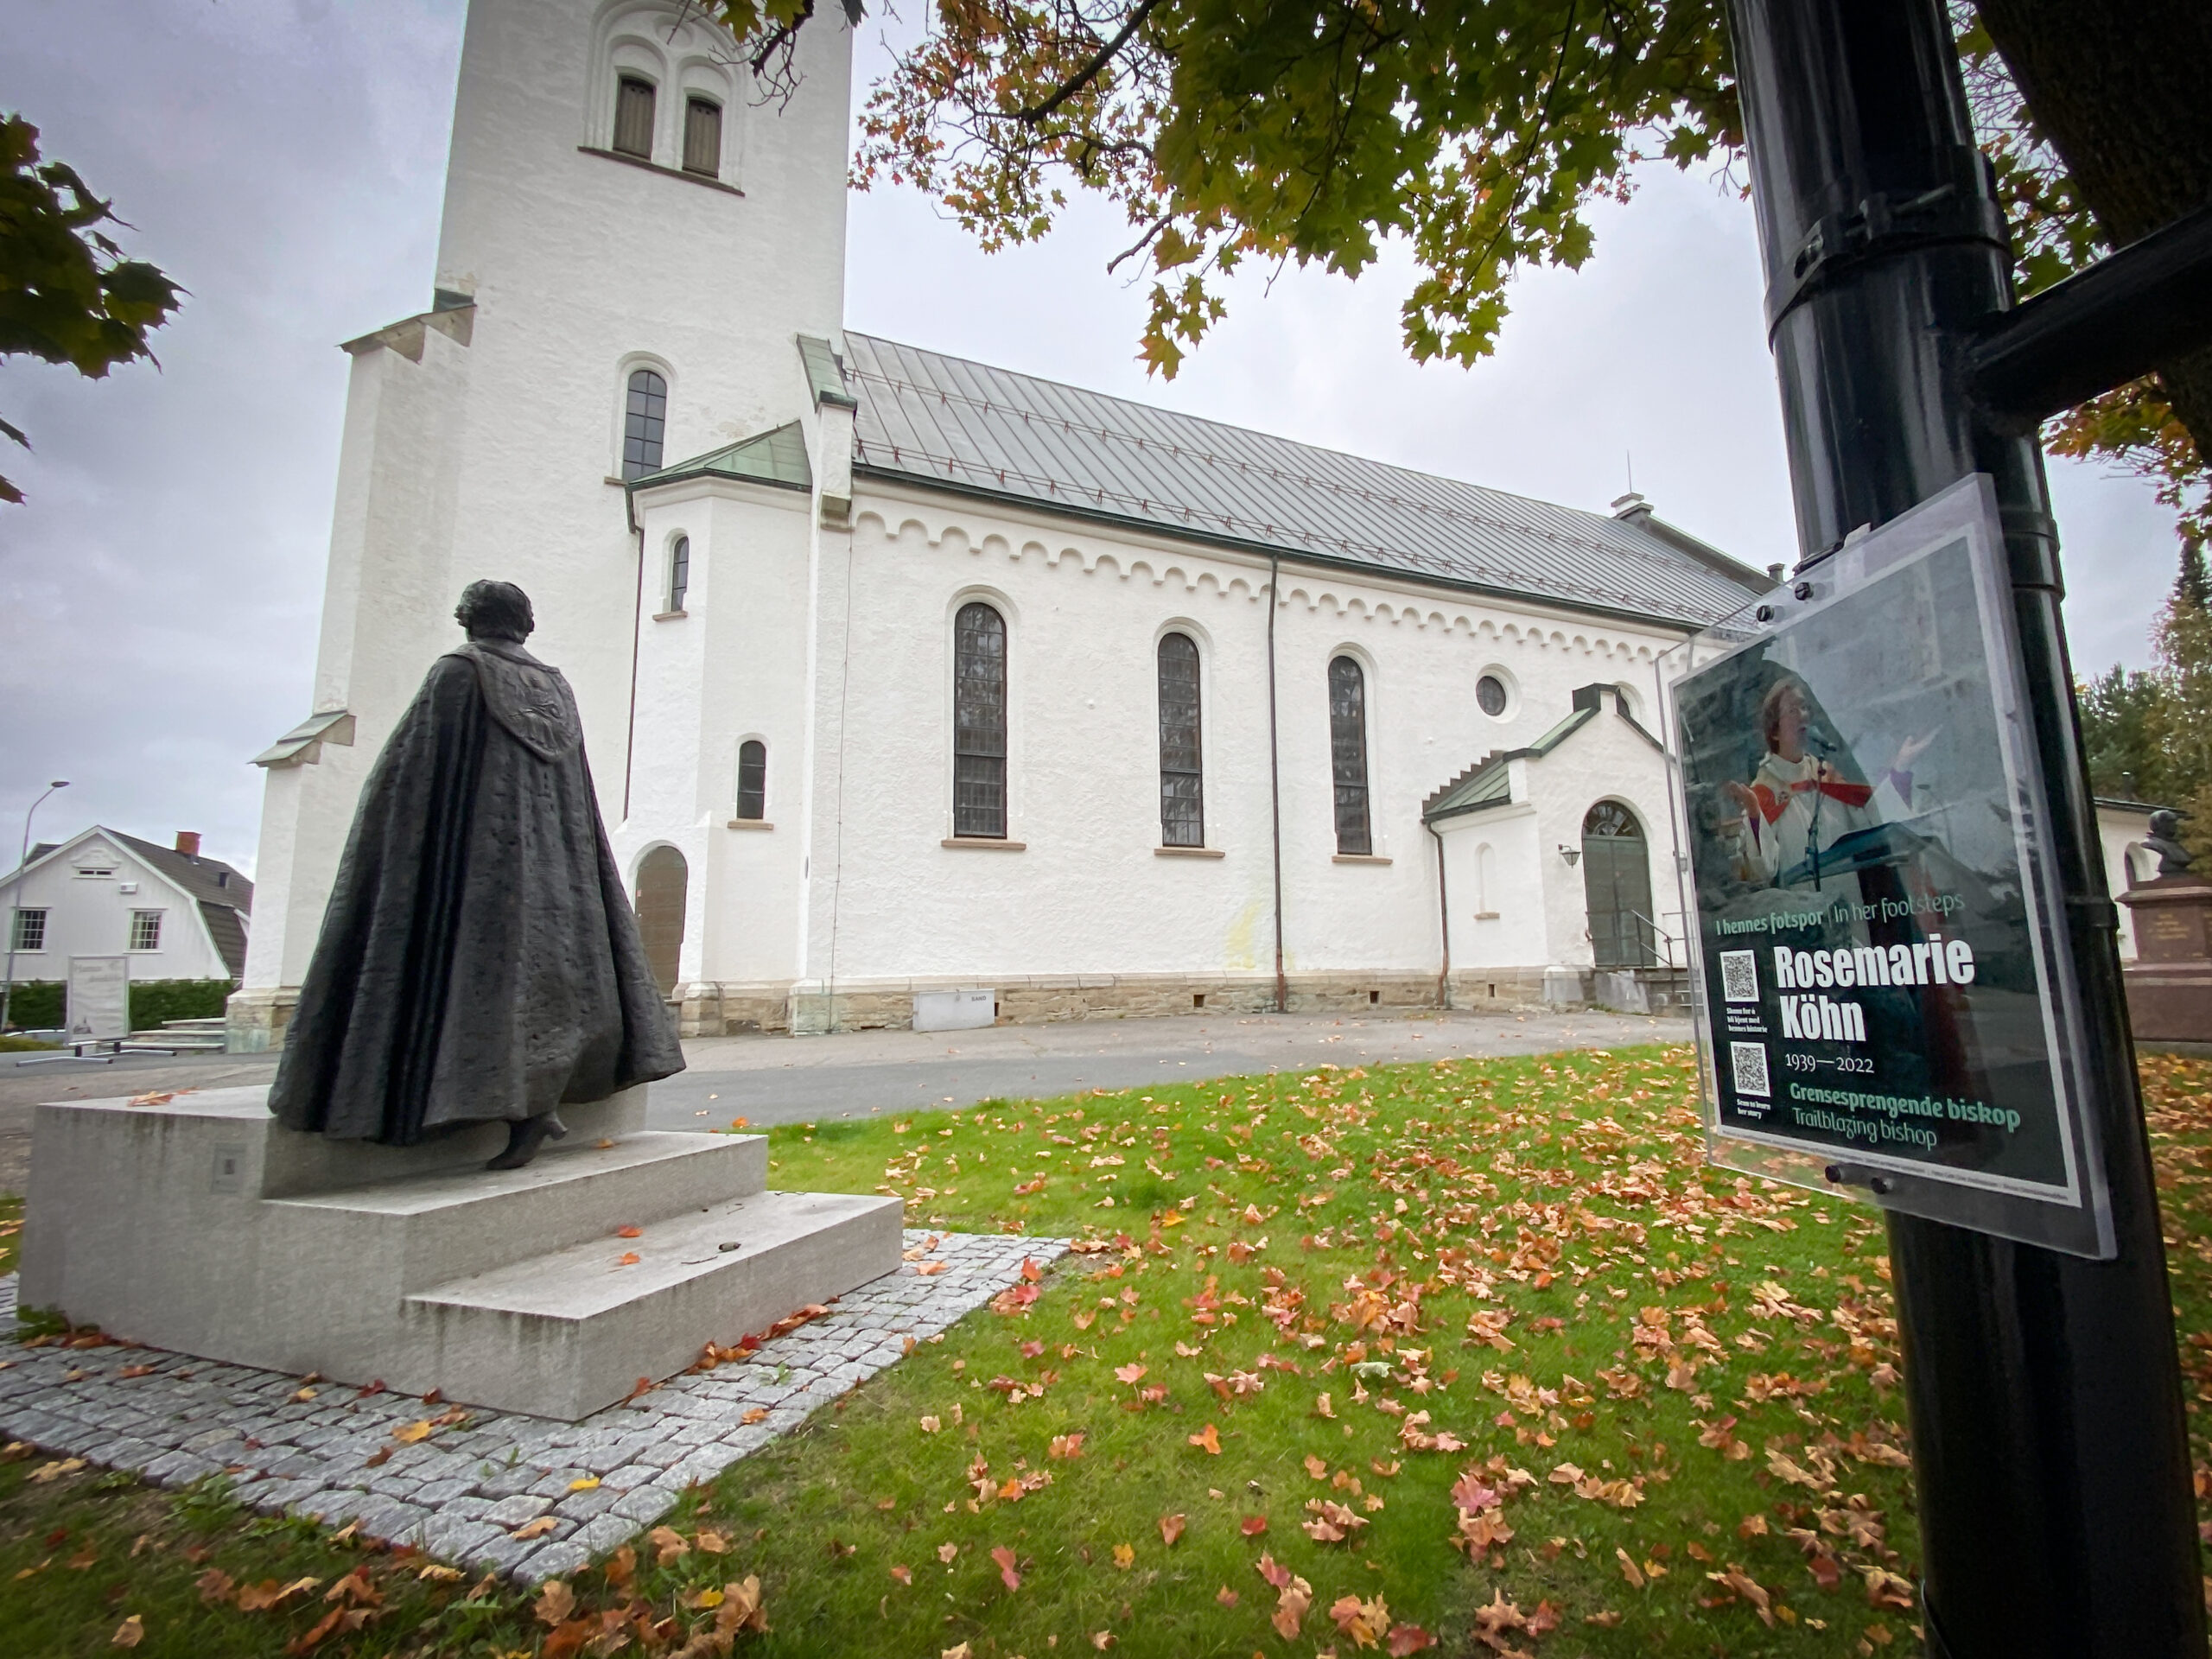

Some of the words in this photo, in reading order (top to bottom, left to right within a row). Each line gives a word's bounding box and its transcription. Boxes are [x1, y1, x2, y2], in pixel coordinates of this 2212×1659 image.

[1716, 919, 1721, 936] I
[1722, 918, 1768, 935] hennes
[1770, 910, 1823, 935] fotspor
[1834, 905, 1849, 923] In
[1852, 902, 1878, 922] her
[1880, 893, 1965, 924] footsteps
[1773, 933, 1975, 988] Rosemarie
[1779, 994, 1866, 1042] Köhn
[1789, 1082, 1943, 1118] Grensesprengende
[1947, 1096, 2021, 1134] biskop
[1792, 1107, 1878, 1144] Trailblazing
[1880, 1118, 1937, 1152] bishop
